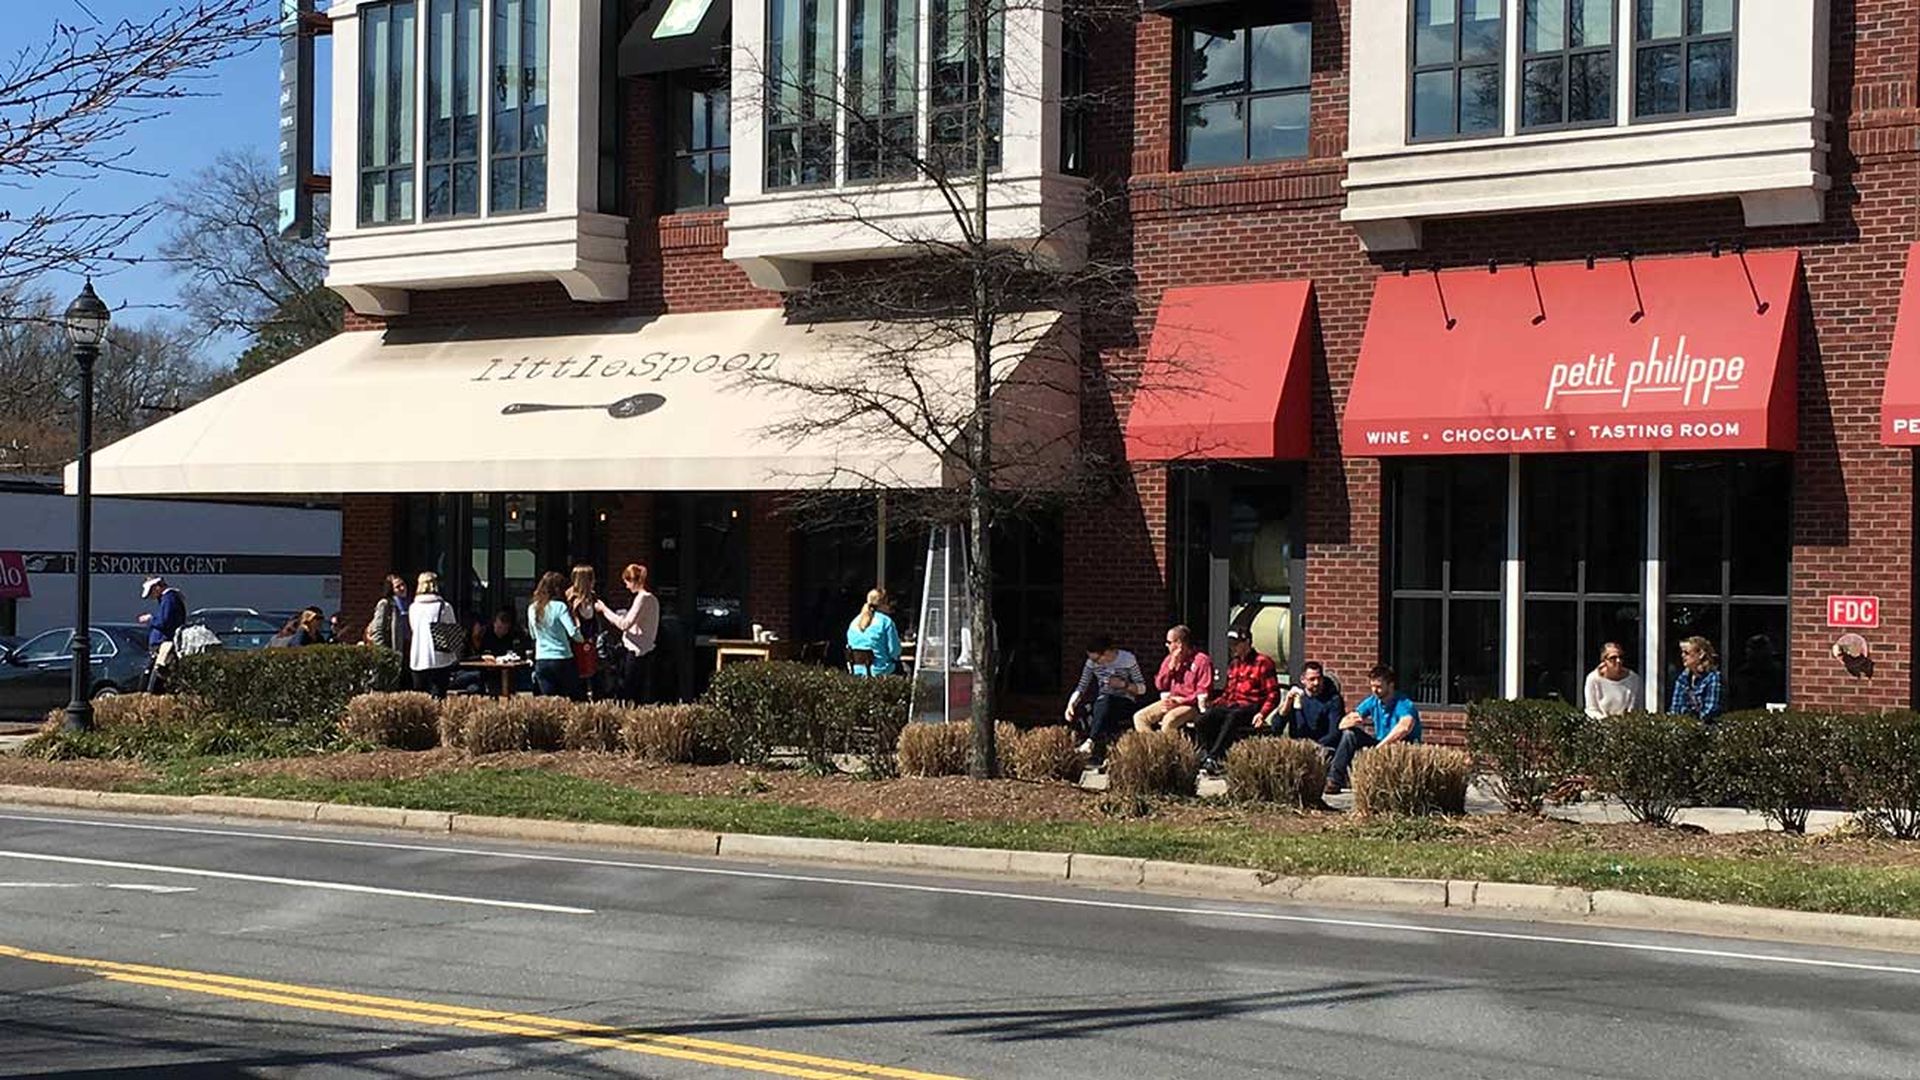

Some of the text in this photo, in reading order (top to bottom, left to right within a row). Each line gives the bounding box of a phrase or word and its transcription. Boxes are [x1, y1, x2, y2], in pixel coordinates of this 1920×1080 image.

[471, 351, 780, 382] littleSpoon
[1545, 335, 1744, 410] petit philippe
[1366, 422, 1740, 444] WINE CHOCOLATE TASTING ROOM
[101, 555, 180, 573] SPORTING
[184, 556, 226, 573] GENT
[1833, 600, 1873, 622] FDC
